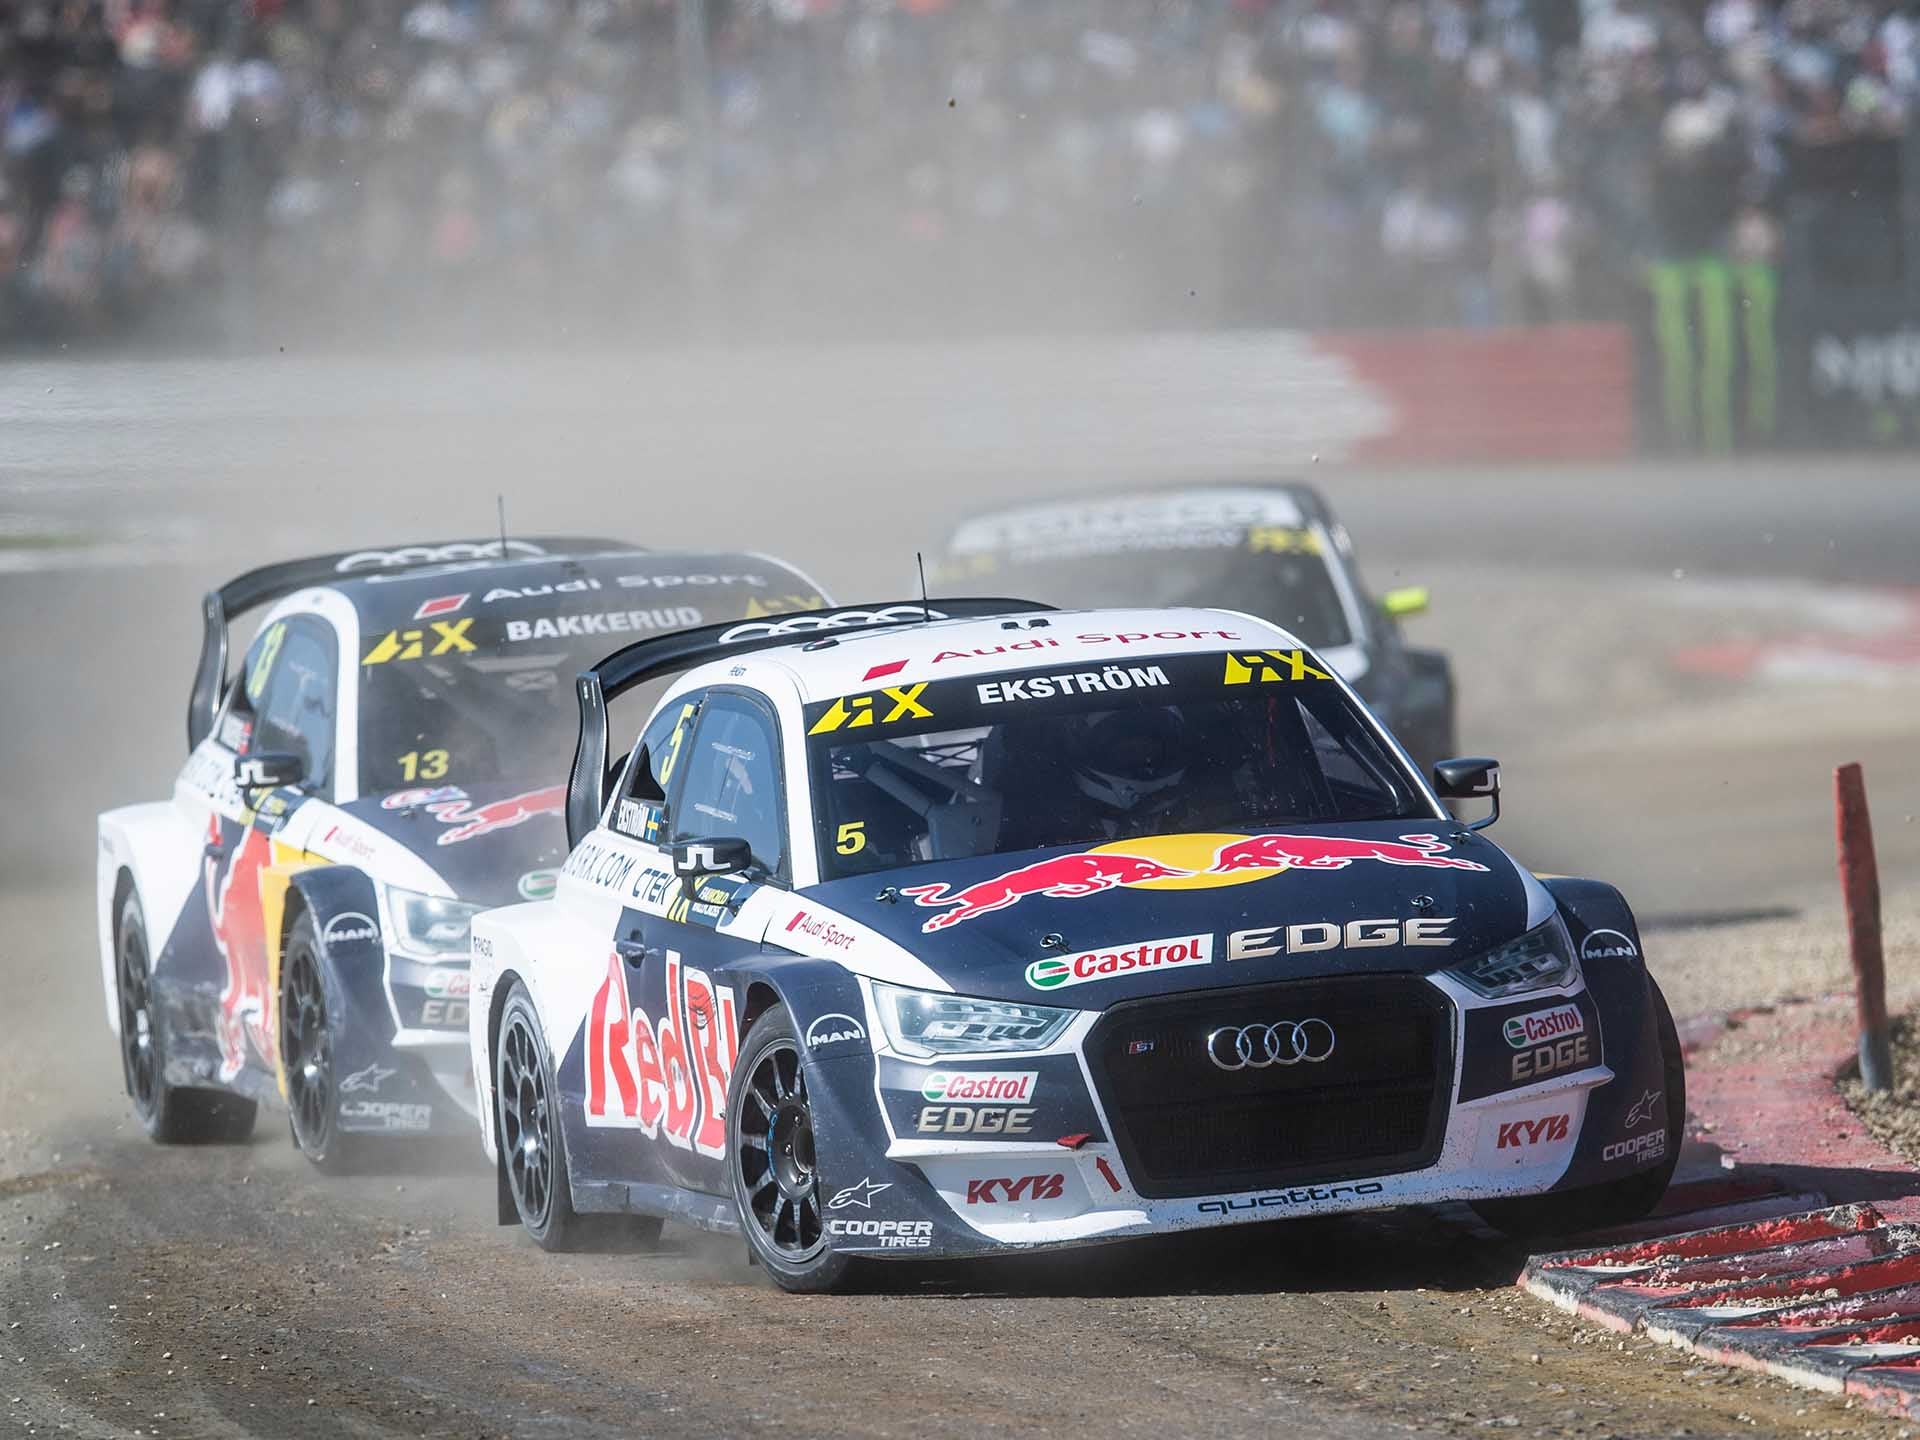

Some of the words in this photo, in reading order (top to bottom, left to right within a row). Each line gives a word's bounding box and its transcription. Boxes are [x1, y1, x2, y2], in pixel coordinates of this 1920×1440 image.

[482, 578, 602, 603] Audi
[615, 573, 768, 588] Sport
[505, 606, 703, 642] BAKKERUD
[931, 638, 1060, 663] Audi
[1077, 628, 1242, 647] Sport
[977, 665, 1170, 705] EKSTRÖM
[659, 703, 695, 785] 5
[398, 749, 450, 782] 13
[835, 821, 867, 857] 5
[632, 867, 679, 905] CTEK
[798, 914, 825, 937] Audi
[821, 922, 857, 950] Sport
[1226, 917, 1458, 962] EDGE
[1073, 938, 1204, 978] Castrol
[1586, 946, 1634, 959] MAN
[421, 1000, 470, 1025] ED
[1524, 1007, 1582, 1041] Castrol
[811, 1030, 861, 1046] MAN
[1511, 1035, 1590, 1082] EDGE
[946, 1075, 1029, 1099] Castrol
[917, 1106, 1039, 1135] EDGE
[1496, 1113, 1570, 1149] KYB
[1602, 1128, 1666, 1162] COOPER
[1634, 1145, 1666, 1164] TIRES
[966, 1173, 1065, 1205] KYB
[1196, 1181, 1384, 1215] quattro
[828, 1219, 934, 1237] COOPER
[877, 1236, 932, 1248] TIRES
